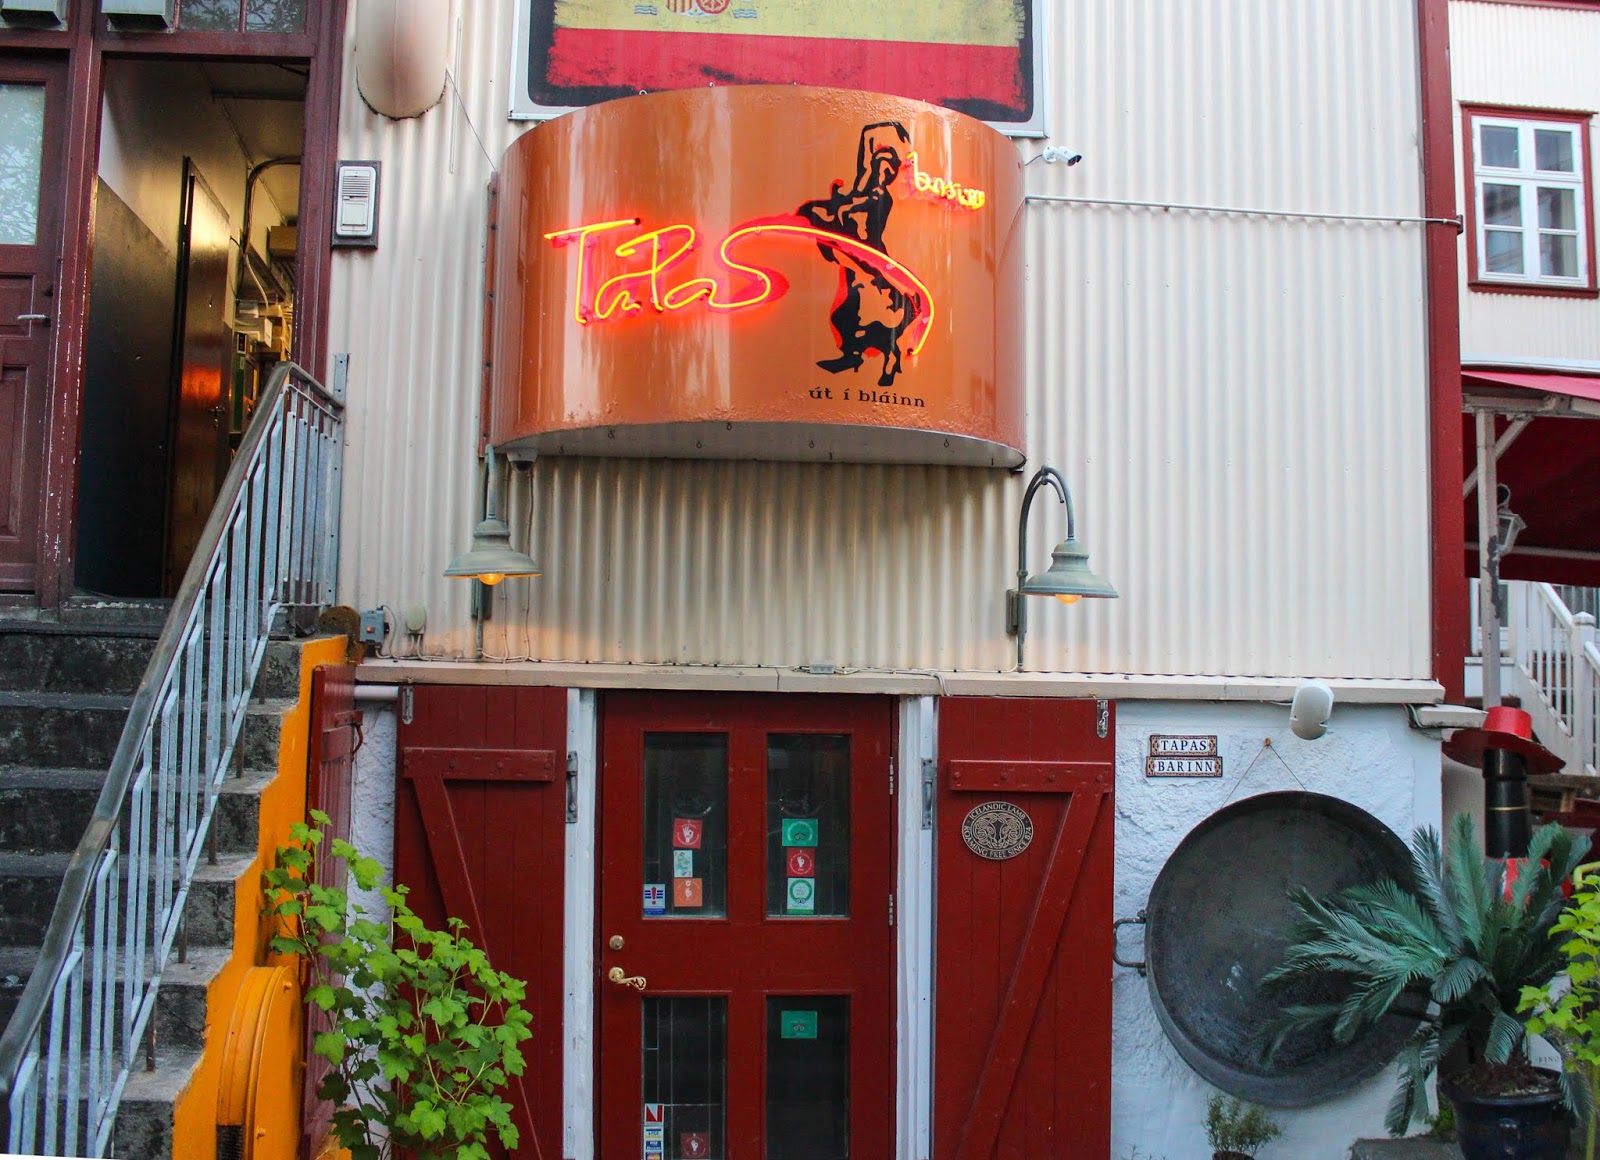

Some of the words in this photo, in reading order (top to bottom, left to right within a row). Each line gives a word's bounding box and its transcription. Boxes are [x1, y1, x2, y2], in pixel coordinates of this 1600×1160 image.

[808, 386, 833, 400] út
[843, 388, 850, 401] í
[858, 389, 926, 408] bláinn
[1160, 740, 1207, 751] TAPAS
[1157, 761, 1213, 772] BARINN
[969, 803, 1007, 820] ICELANDIC
[1007, 804, 1026, 820] LAMB
[963, 825, 988, 856] ROAMING
[1008, 840, 1028, 855] SINCE
